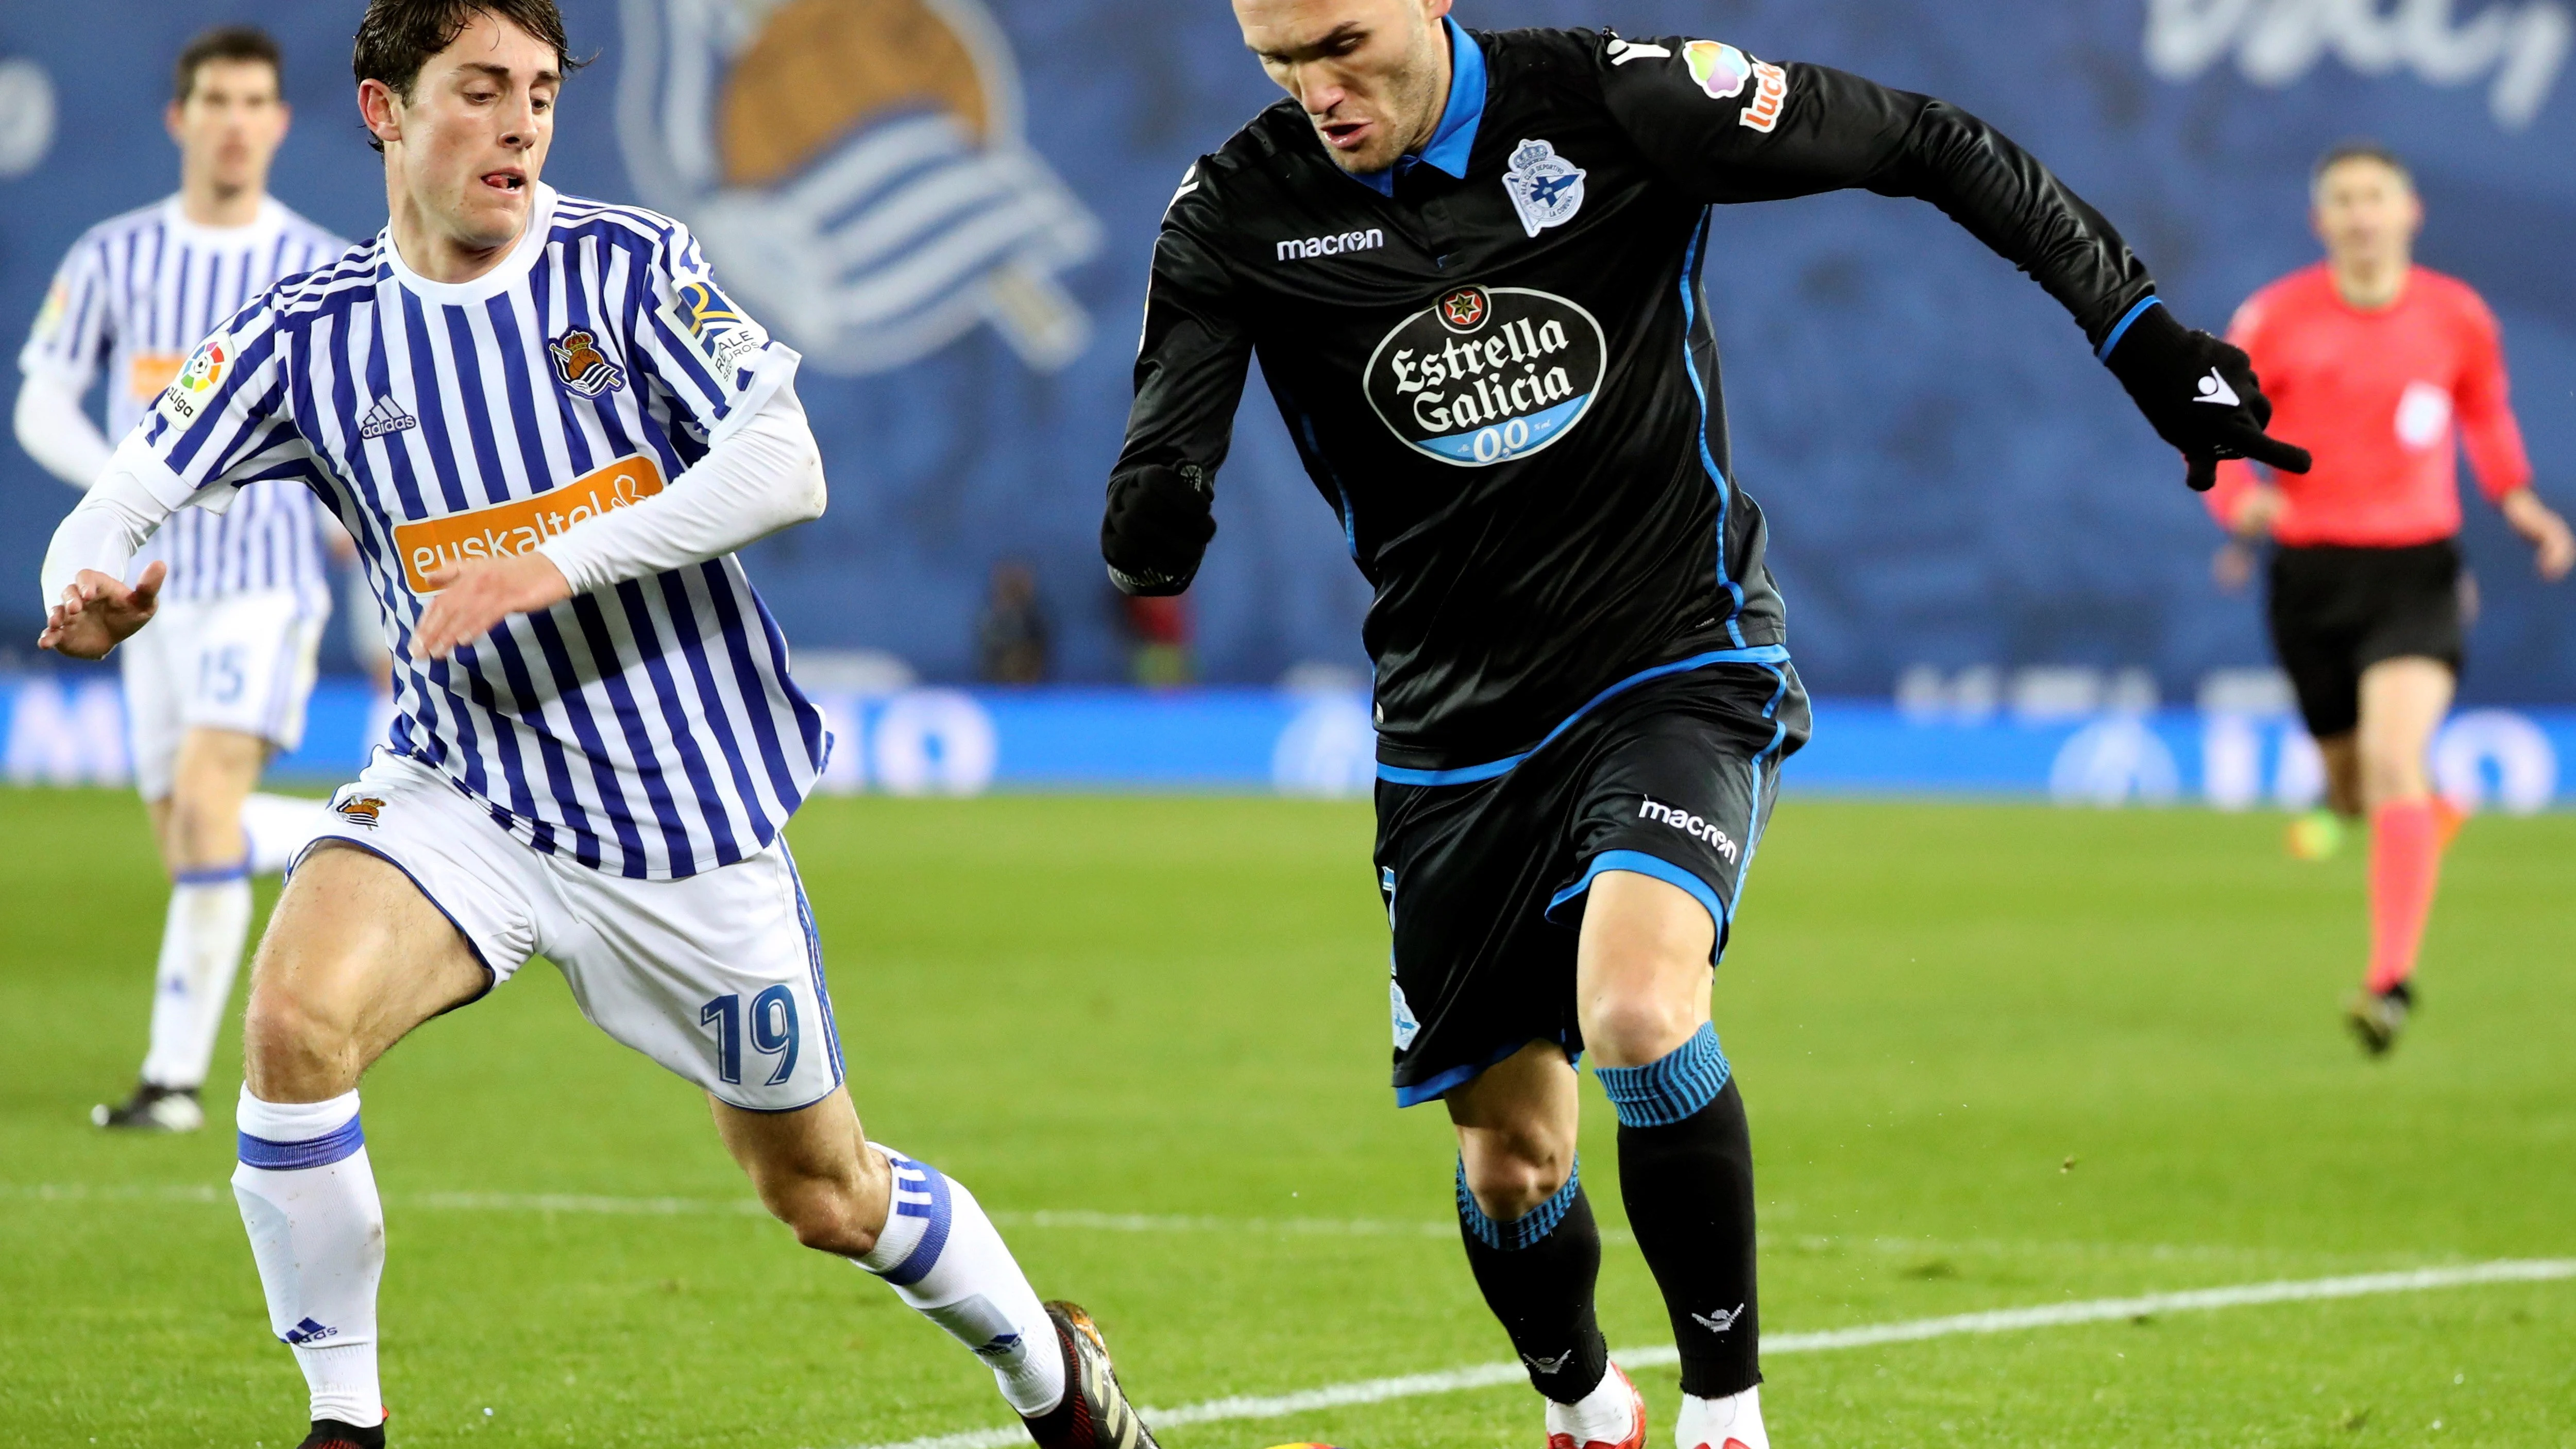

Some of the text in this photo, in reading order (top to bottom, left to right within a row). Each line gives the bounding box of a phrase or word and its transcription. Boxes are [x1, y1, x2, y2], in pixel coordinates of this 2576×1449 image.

[1277, 228, 1383, 261] macron
[1392, 317, 1569, 395] Estrella
[362, 416, 415, 438] adidas
[1413, 363, 1574, 433] Galicia
[1473, 419, 1529, 462] 0,0
[1638, 800, 1737, 865] macron
[701, 984, 799, 1086] 19
